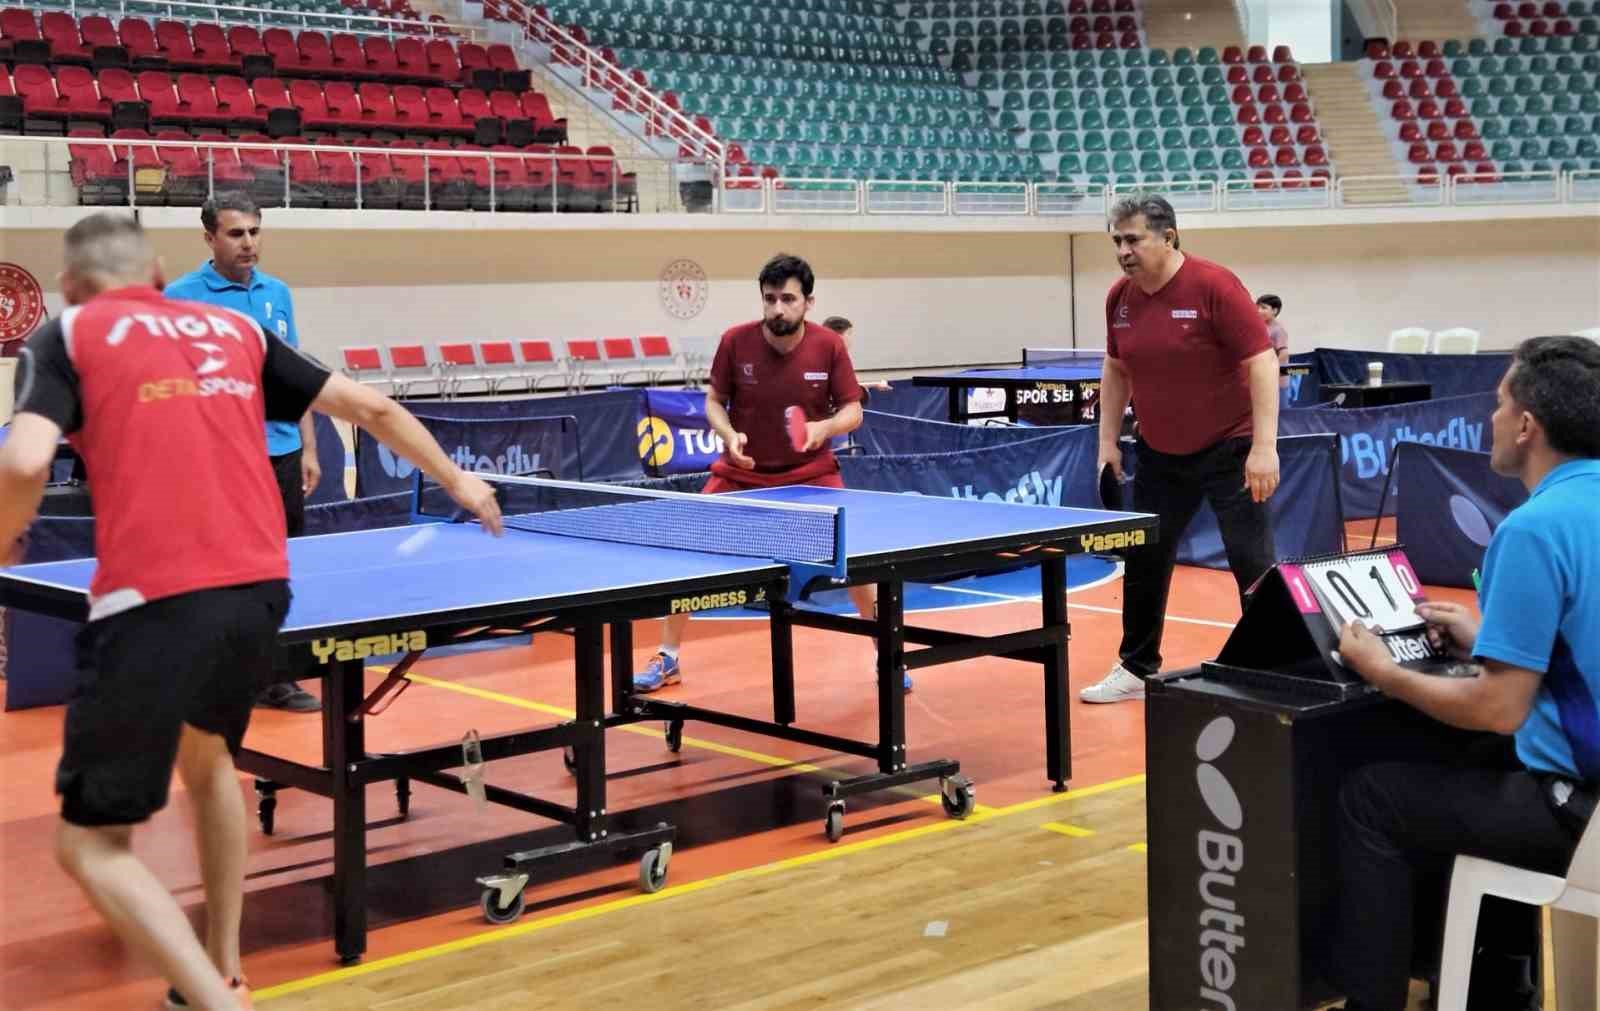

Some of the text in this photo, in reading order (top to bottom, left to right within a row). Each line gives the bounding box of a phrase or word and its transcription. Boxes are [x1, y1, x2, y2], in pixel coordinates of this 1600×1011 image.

[106, 313, 243, 346] STIGA
[1016, 389, 1049, 405] SPOR
[1080, 529, 1146, 553] Yasaka
[1293, 576, 1313, 609] 1
[1396, 563, 1419, 595] 0
[670, 590, 748, 614] PROGRESS
[311, 630, 428, 664] Yasaka
